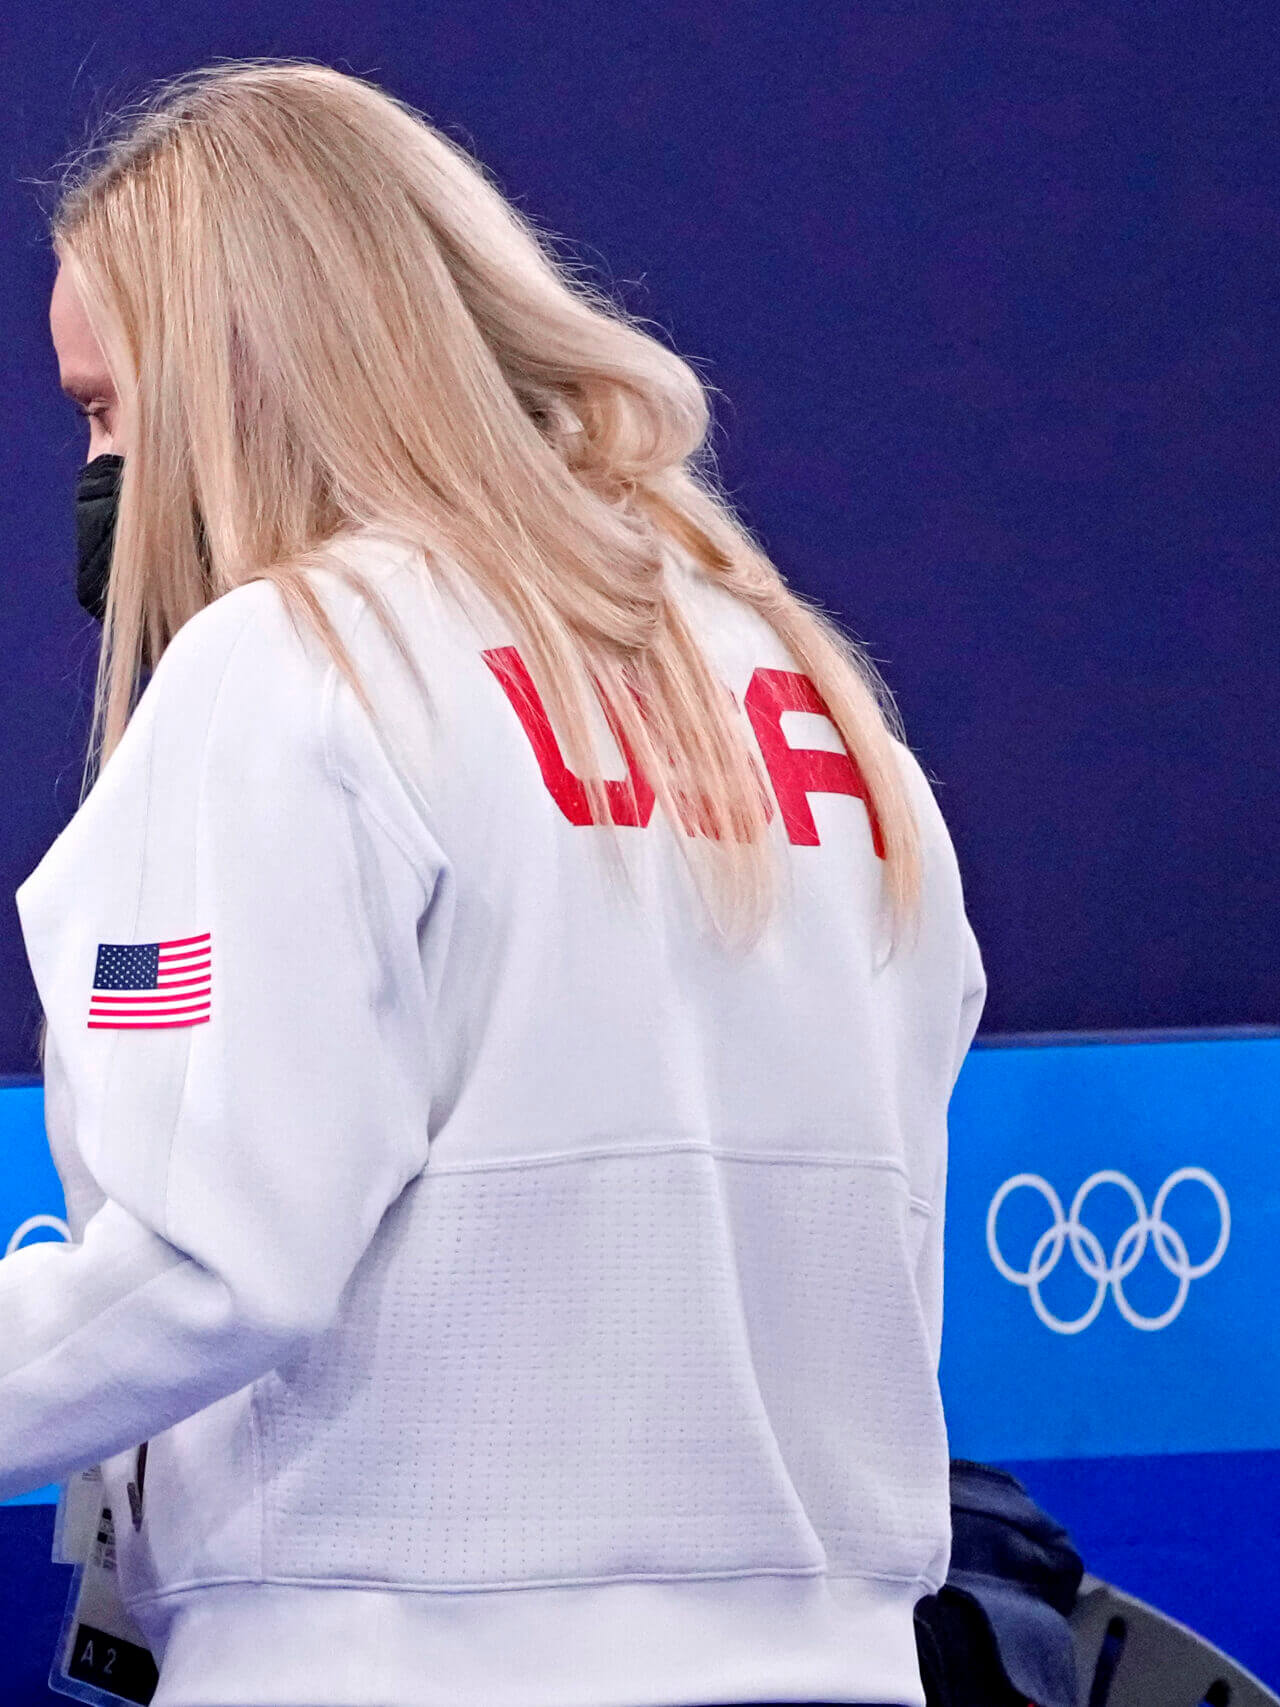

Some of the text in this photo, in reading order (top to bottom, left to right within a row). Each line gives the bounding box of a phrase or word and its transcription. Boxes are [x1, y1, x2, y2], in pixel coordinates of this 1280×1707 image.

[482, 645, 886, 860] UA
[80, 1640, 117, 1675] A 2
